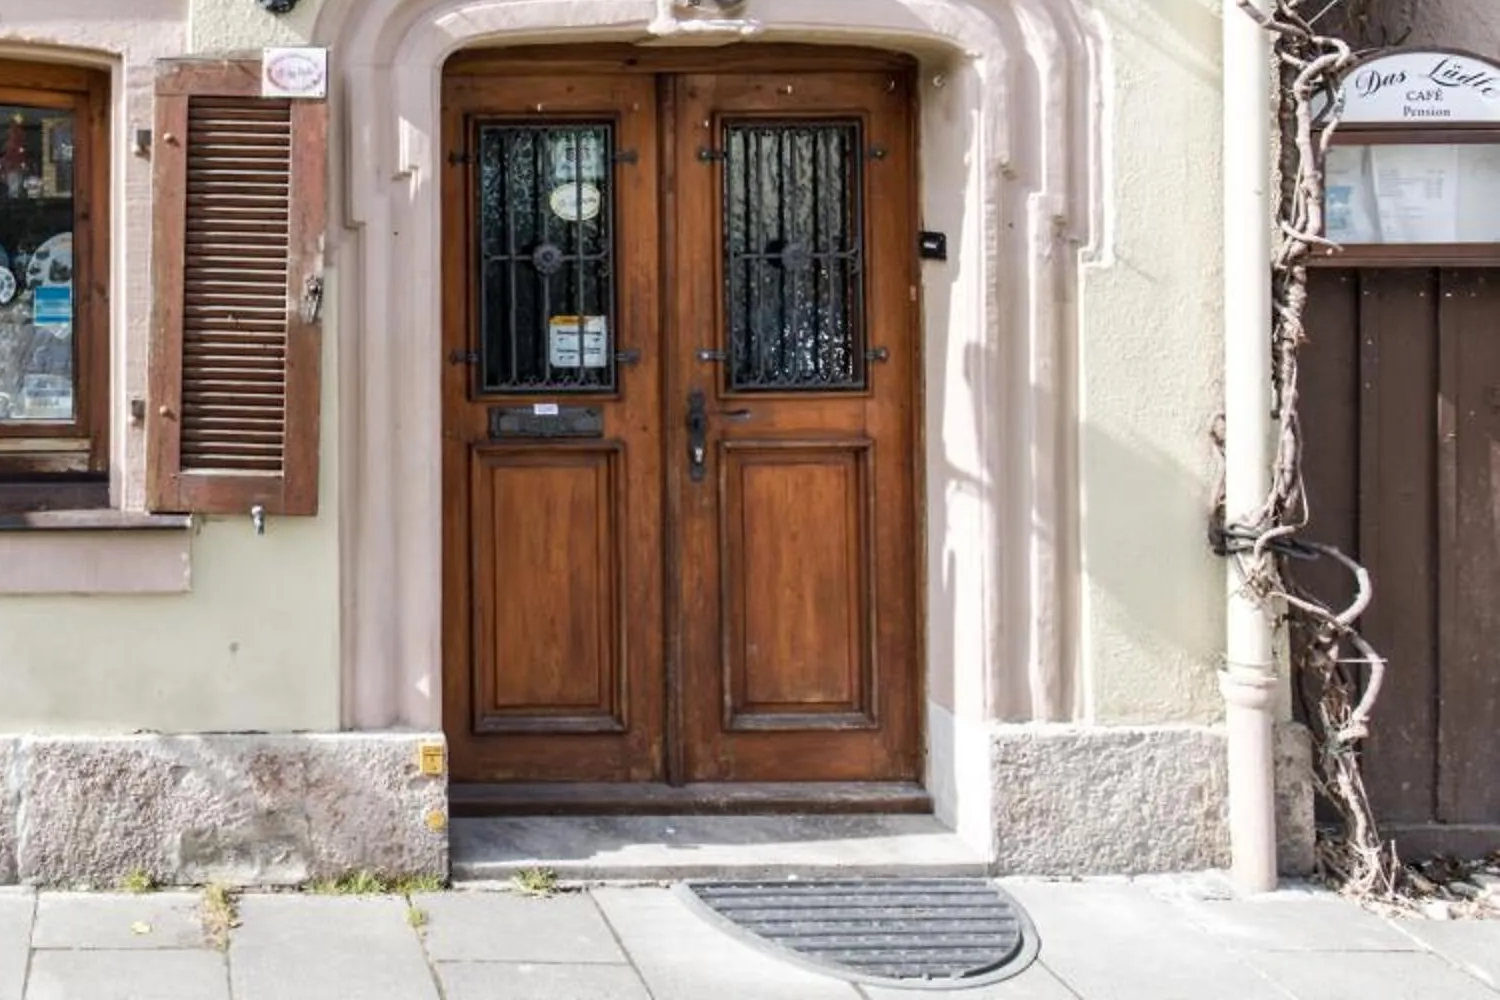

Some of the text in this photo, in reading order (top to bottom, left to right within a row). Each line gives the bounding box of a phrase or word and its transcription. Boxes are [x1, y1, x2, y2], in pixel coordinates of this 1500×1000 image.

[1355, 69, 1407, 98] Das
[1406, 87, 1443, 102] CAFÉ
[1403, 105, 1451, 118] Pension
